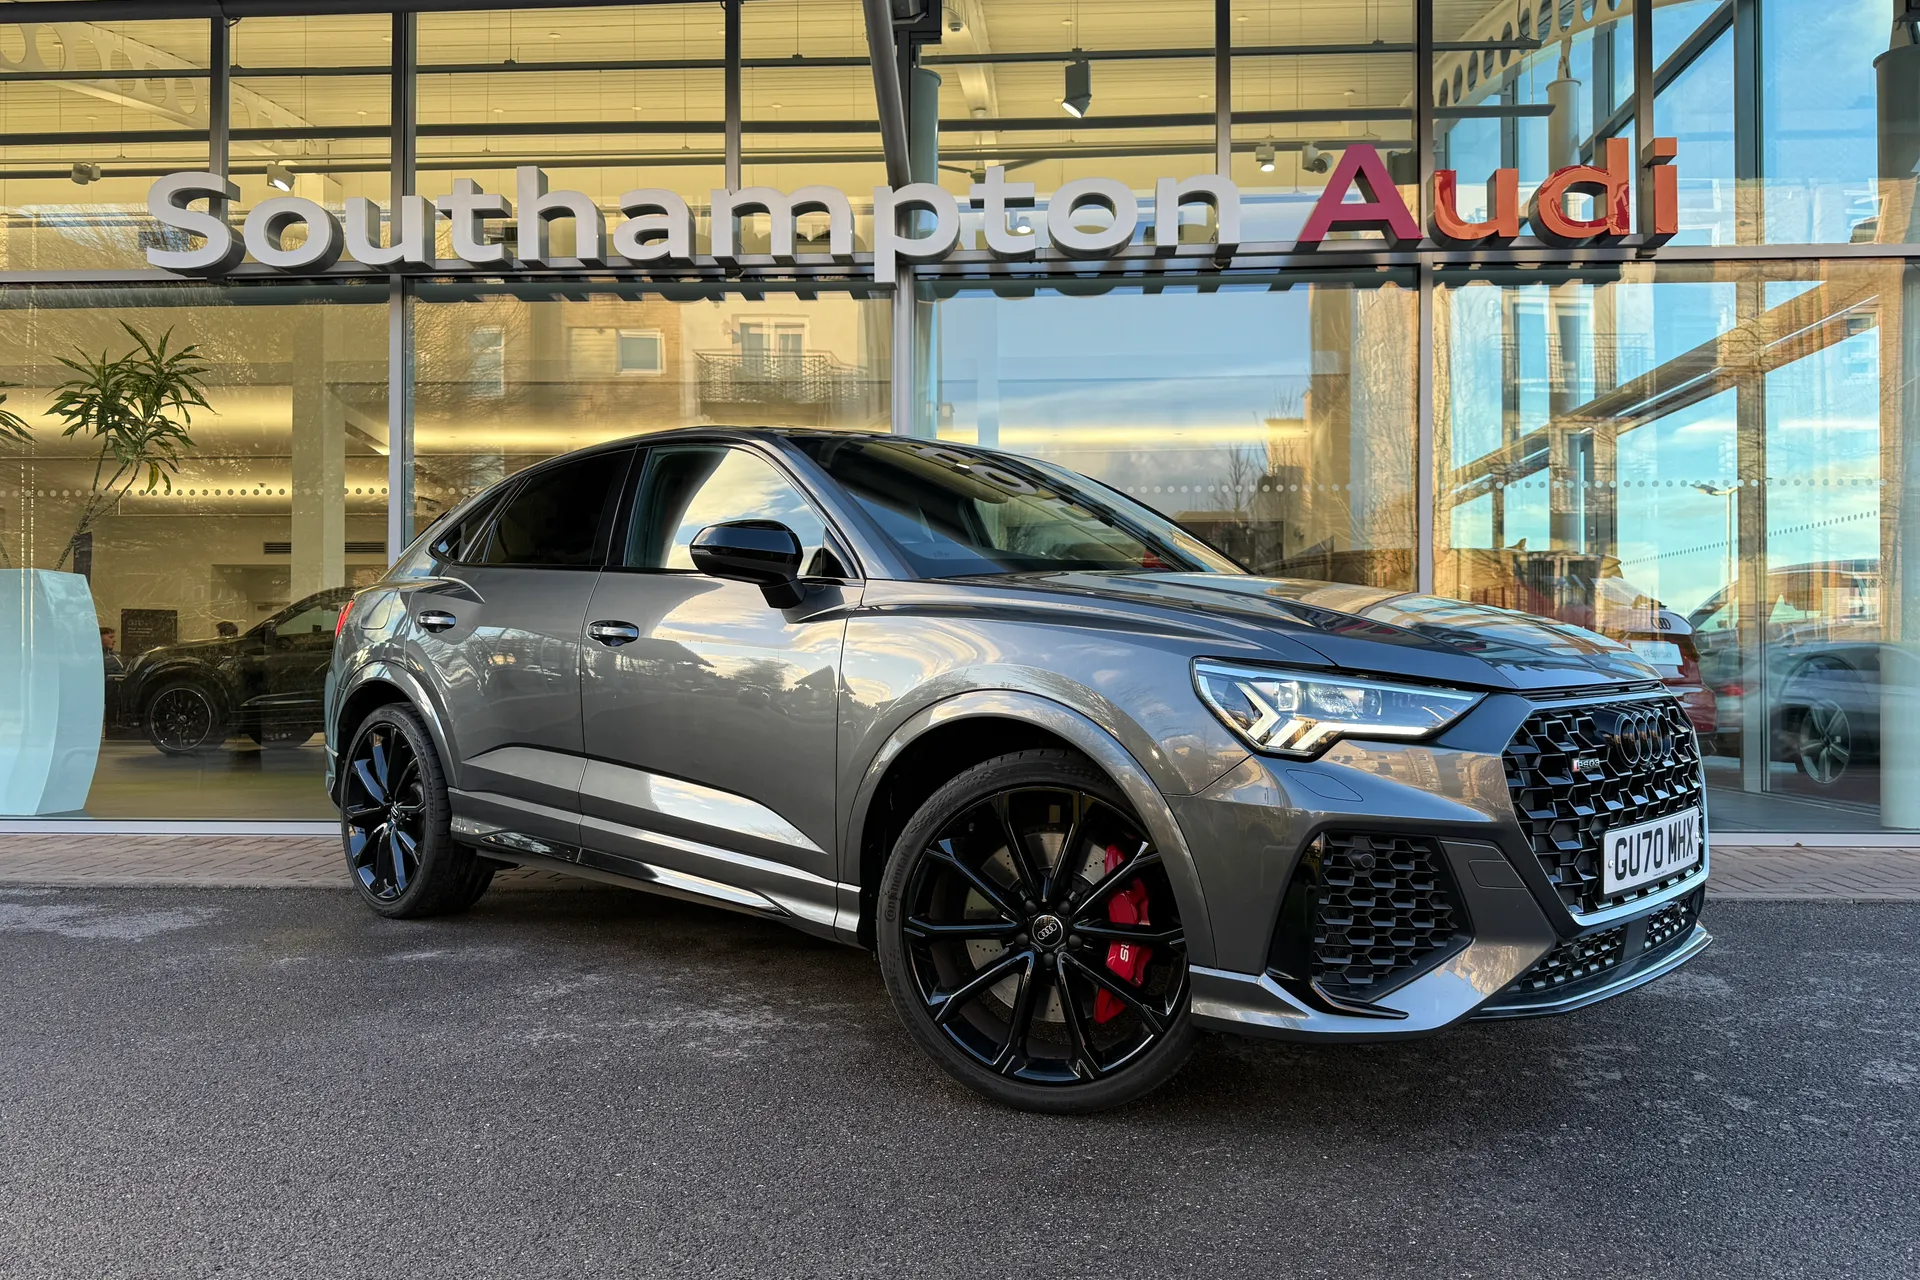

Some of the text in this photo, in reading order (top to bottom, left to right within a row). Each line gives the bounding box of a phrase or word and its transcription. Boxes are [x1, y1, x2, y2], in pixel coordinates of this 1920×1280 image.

[147, 137, 1678, 284] Southampton Audi
[1615, 815, 1694, 881] GU70 MHX
